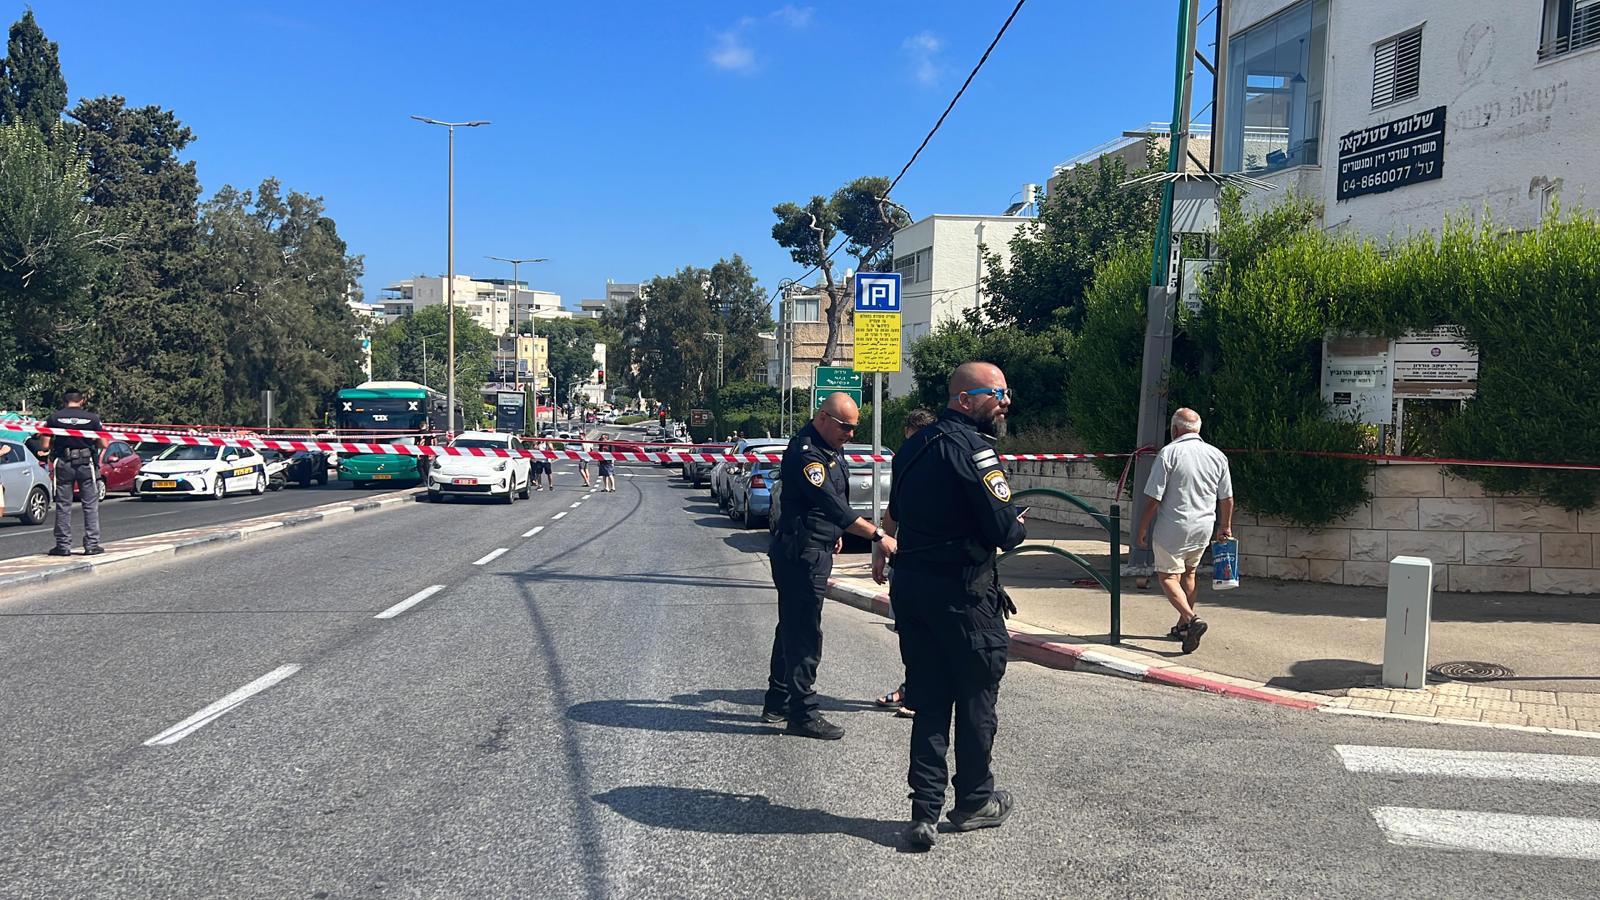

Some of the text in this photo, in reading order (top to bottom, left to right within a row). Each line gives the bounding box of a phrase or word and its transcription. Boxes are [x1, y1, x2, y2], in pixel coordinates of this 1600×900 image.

[1393, 112, 1434, 135] שלומי
[1388, 147, 1409, 161] עורכי
[1413, 140, 1437, 156] משרד
[1375, 154, 1385, 168] דין
[1342, 165, 1411, 193] 04-8660077
